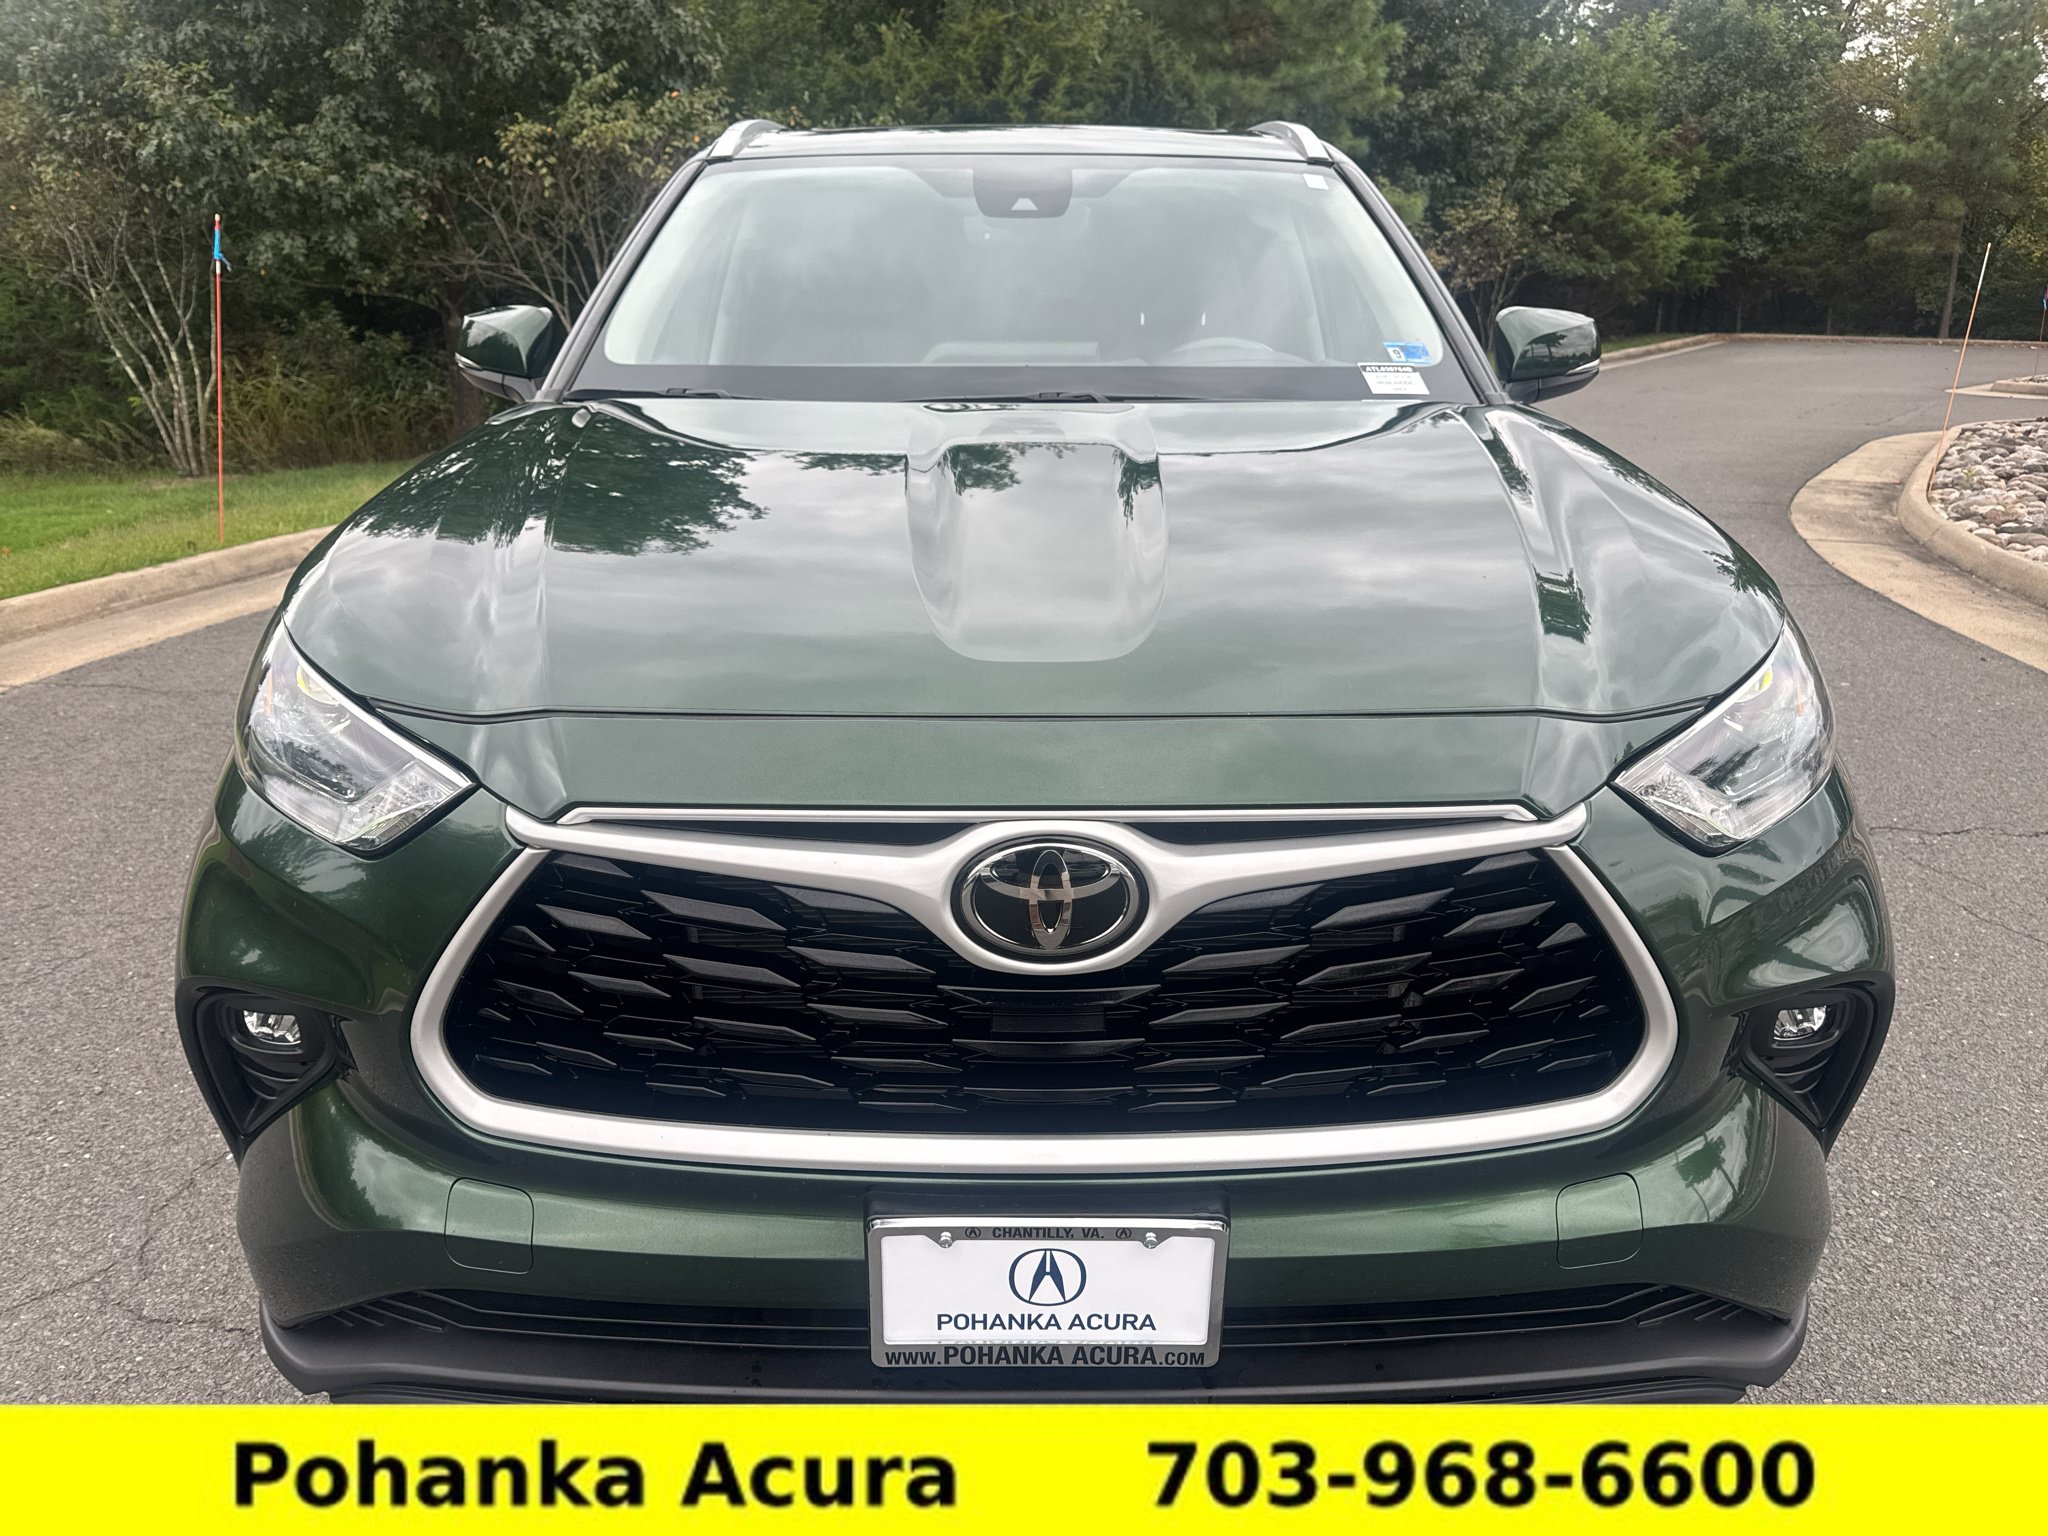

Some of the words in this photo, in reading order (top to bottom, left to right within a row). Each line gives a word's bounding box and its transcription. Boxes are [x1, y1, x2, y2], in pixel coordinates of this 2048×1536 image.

[1392, 349, 1402, 359] 9
[992, 1227, 1074, 1239] CHANTILLY,
[1081, 1227, 1105, 1239] VA.
[936, 1313, 1062, 1331] POHANKA
[1067, 1313, 1157, 1331] ACURA
